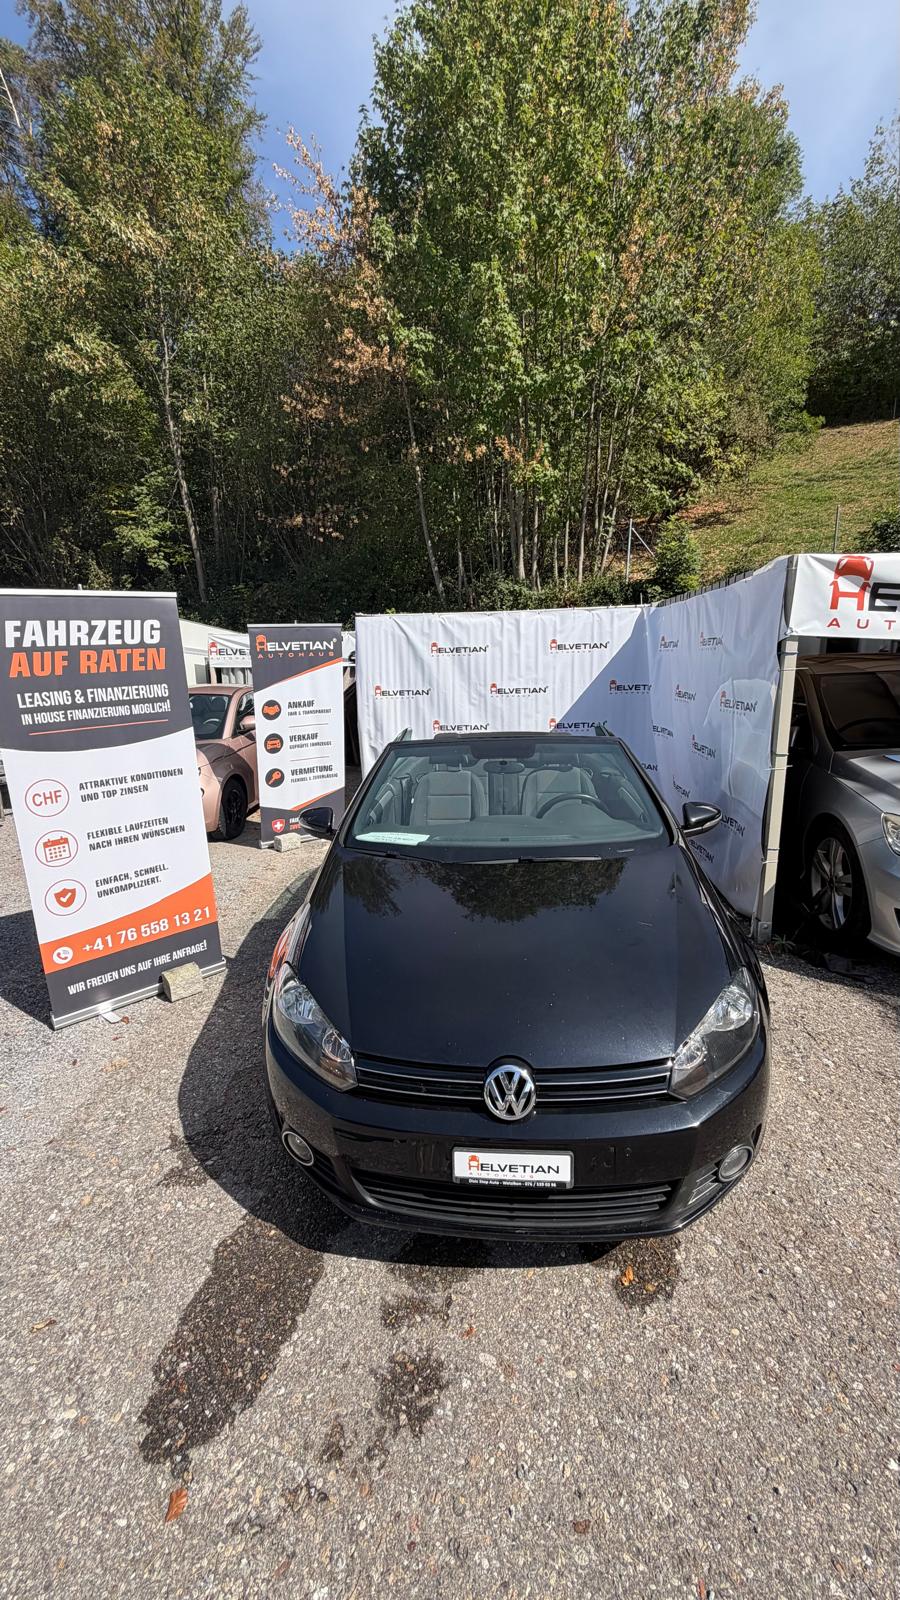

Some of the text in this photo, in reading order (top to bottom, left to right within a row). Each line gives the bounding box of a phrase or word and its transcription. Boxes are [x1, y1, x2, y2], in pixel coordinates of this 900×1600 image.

[826, 617, 897, 630] AUT
[4, 619, 161, 648] FAHRZEUG
[209, 642, 250, 656] HELVE
[255, 634, 334, 652] HELVETIAN
[431, 642, 487, 654] HELVETIAN
[550, 639, 607, 651] HELVETIAN
[9, 647, 166, 678] AUF RATEN
[257, 651, 334, 659] AUTOHAUS
[16, 683, 169, 709] LEASING & FINANZIERUNG
[375, 685, 429, 696] HELVETIAN
[490, 683, 546, 694] HELVETIAN
[288, 699, 315, 709] ANKAUF
[20, 713, 33, 726] IN
[33, 711, 66, 724] HOUSE
[67, 706, 131, 722] FINANZIERUNG
[432, 719, 488, 731] HELVETIAN
[289, 732, 319, 742] VERKAUF
[79, 767, 184, 791] ATTRAKTIVE KONDITIONEN
[290, 764, 333, 776] VERMIETUNG
[32, 789, 62, 807] CHF
[80, 784, 149, 803] UND TOP ZINSEN
[86, 816, 169, 840] FLEXIBLE LAUFZEITEN
[88, 825, 186, 852] NACH IHREN WÜNSCHEN
[95, 863, 169, 888] EINFACH, SCHNELL.
[97, 876, 162, 899] UNKOMPLIZIERT.
[82, 906, 211, 952] +41 76 558 13 21
[67, 939, 208, 995] WIR FREUEN UNS AUF IHRE ANFRAGE!
[468, 1155, 560, 1174] HELVETIAN
